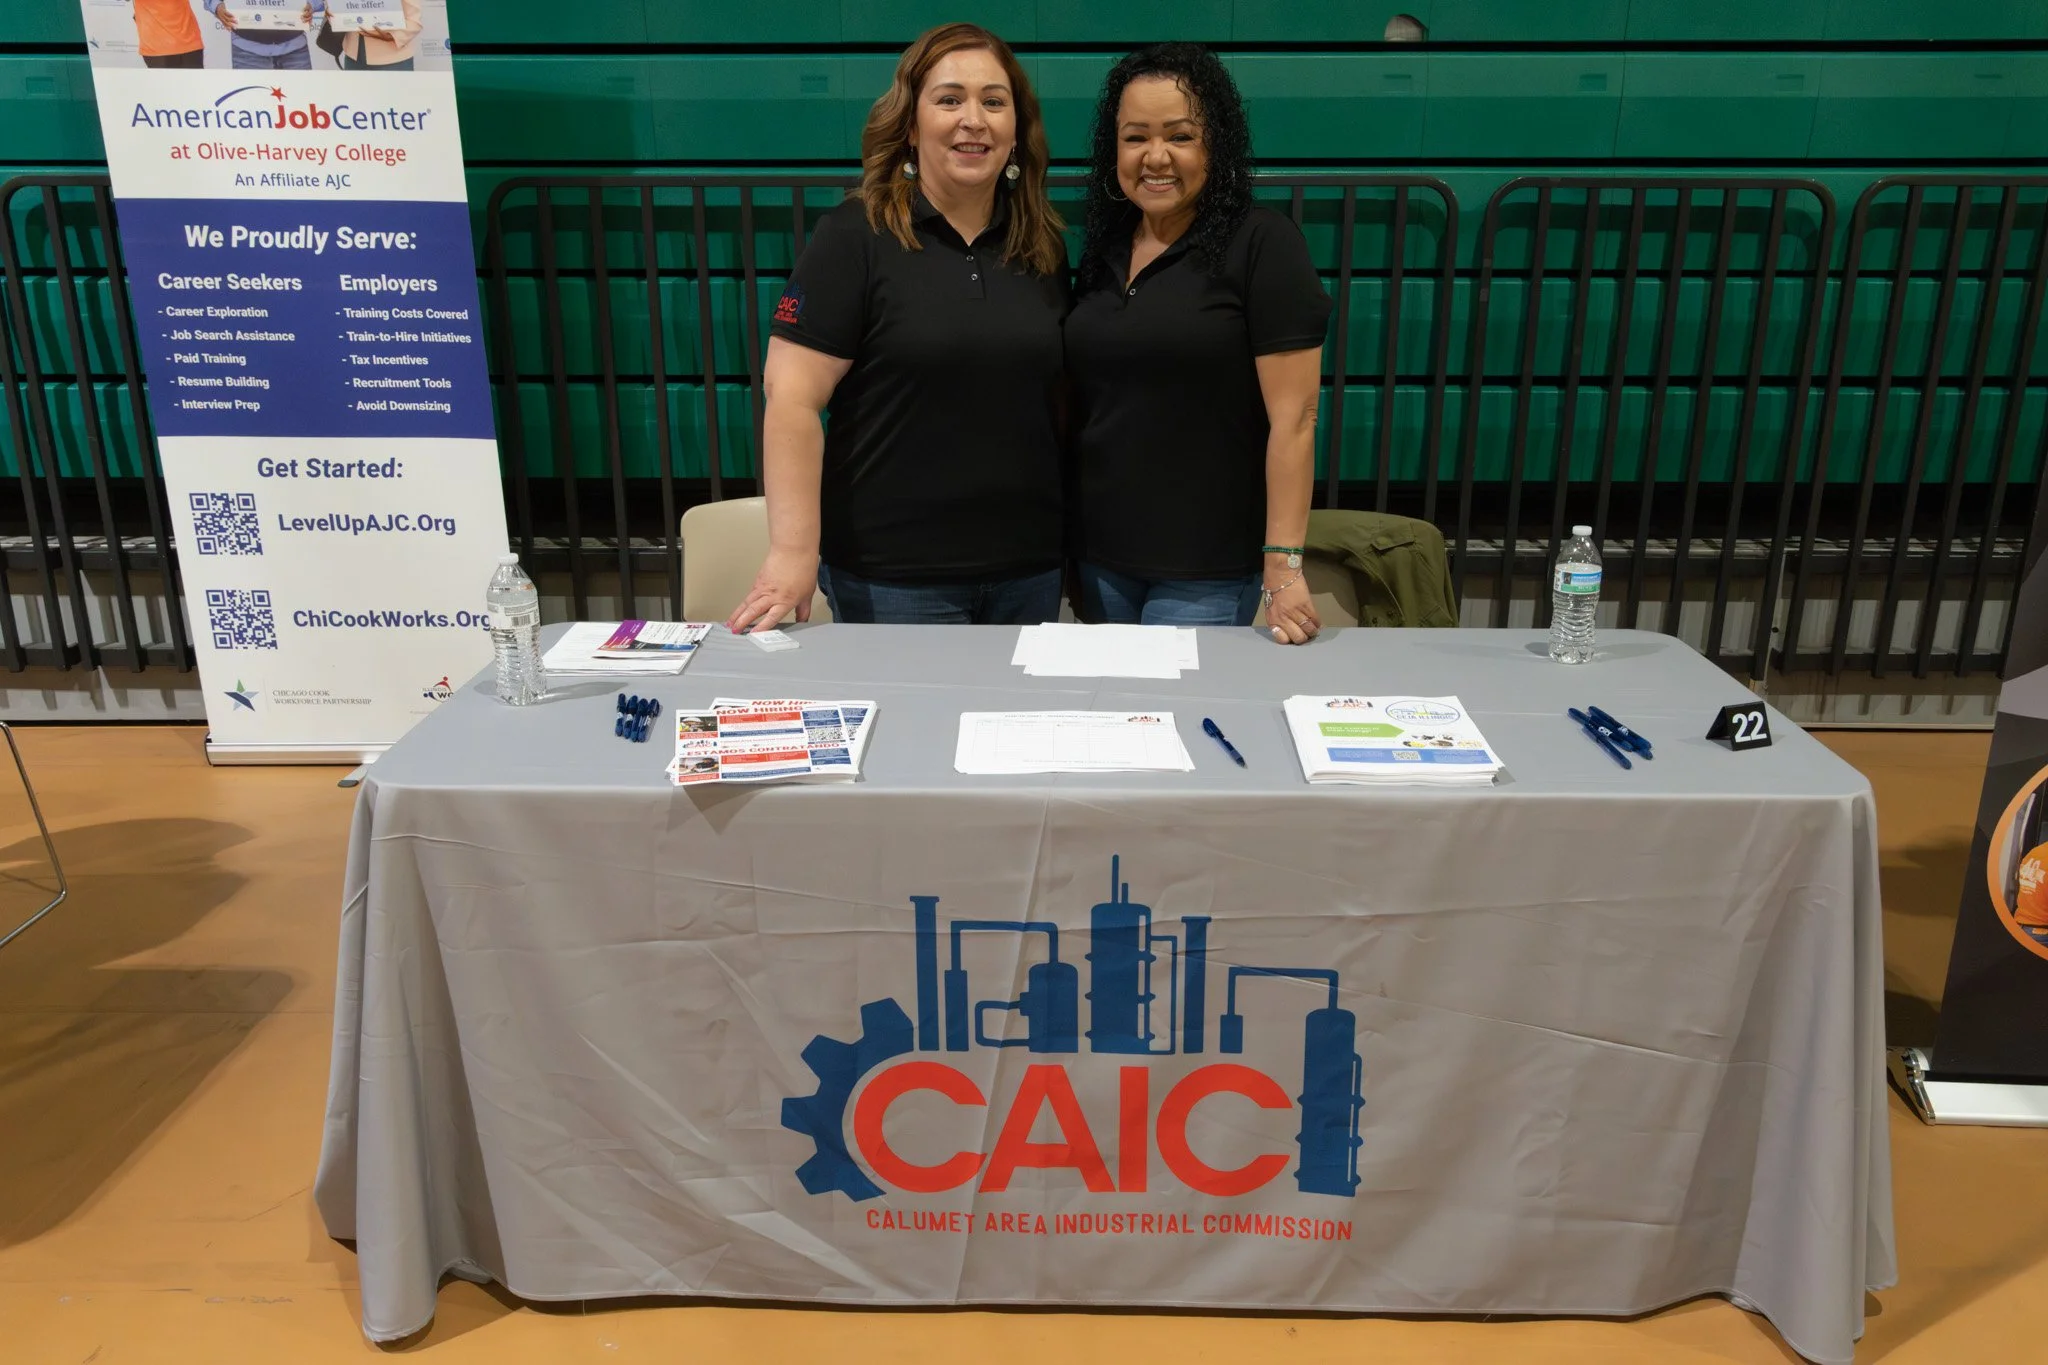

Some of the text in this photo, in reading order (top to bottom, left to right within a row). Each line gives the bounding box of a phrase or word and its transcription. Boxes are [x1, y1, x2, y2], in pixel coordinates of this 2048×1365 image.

[346, 1, 359, 9] the
[171, 143, 406, 166] at Olive-Harvey College
[235, 173, 351, 190] An Affiliate AJC
[185, 225, 416, 255] We Proudly Serve:
[158, 273, 302, 290] Career Seekers
[340, 274, 437, 295] Employers
[166, 306, 268, 319] Career Exploration
[343, 308, 468, 320] Training Costs Covered
[171, 329, 295, 341] Job Search Assistance
[346, 331, 471, 343] Train-to-Hire Initiatives
[174, 353, 246, 366] Paid Training
[350, 355, 428, 365] Tax Incentives
[178, 376, 269, 389] Resume Building
[353, 378, 451, 388] Recruitment Tools
[182, 399, 260, 412] Interview Prep
[357, 400, 451, 413] Avoid Downsizing
[258, 458, 402, 478] Get Started:
[278, 514, 455, 535] LevelUpAJC.Org
[292, 609, 490, 632] ChiCookWorks.Org
[716, 708, 749, 716] NOW
[1732, 711, 1767, 743] 22
[749, 743, 840, 752] CONTRATANDO
[853, 1060, 1294, 1197] CAIC
[867, 1209, 1352, 1240] CALUMET AREA INDUSTRIAL COMMISSION
